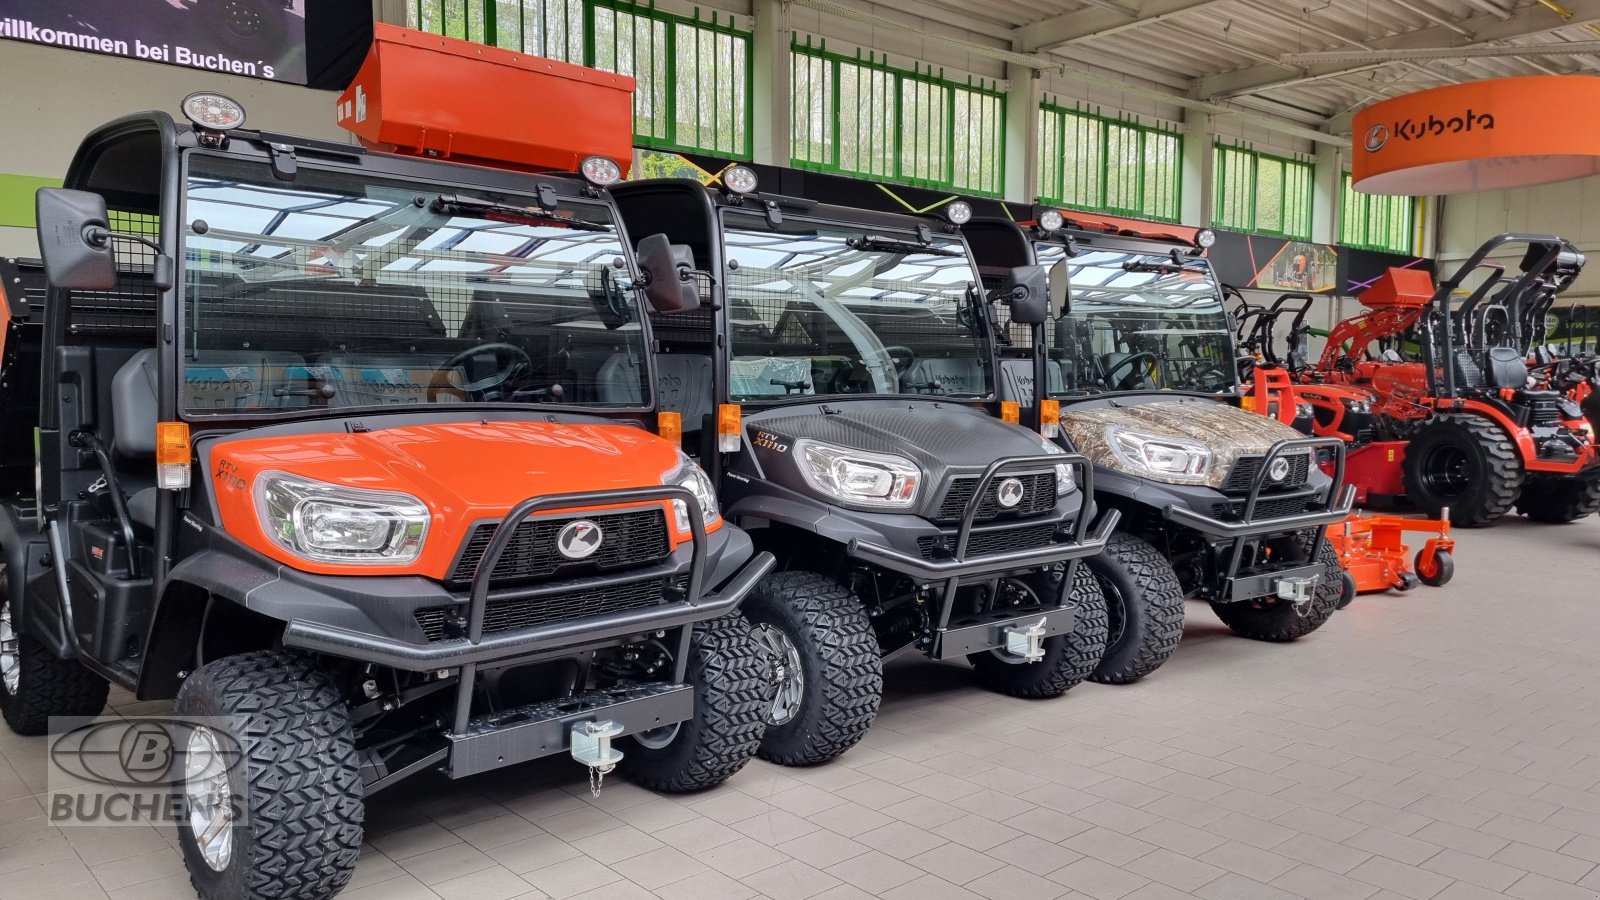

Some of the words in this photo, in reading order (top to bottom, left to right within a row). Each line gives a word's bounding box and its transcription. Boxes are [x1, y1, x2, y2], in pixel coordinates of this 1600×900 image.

[135, 40, 168, 62] bei
[1394, 109, 1495, 141] Kubota
[757, 430, 778, 441] RTV
[753, 437, 788, 453] X1110
[219, 459, 239, 473] RTV
